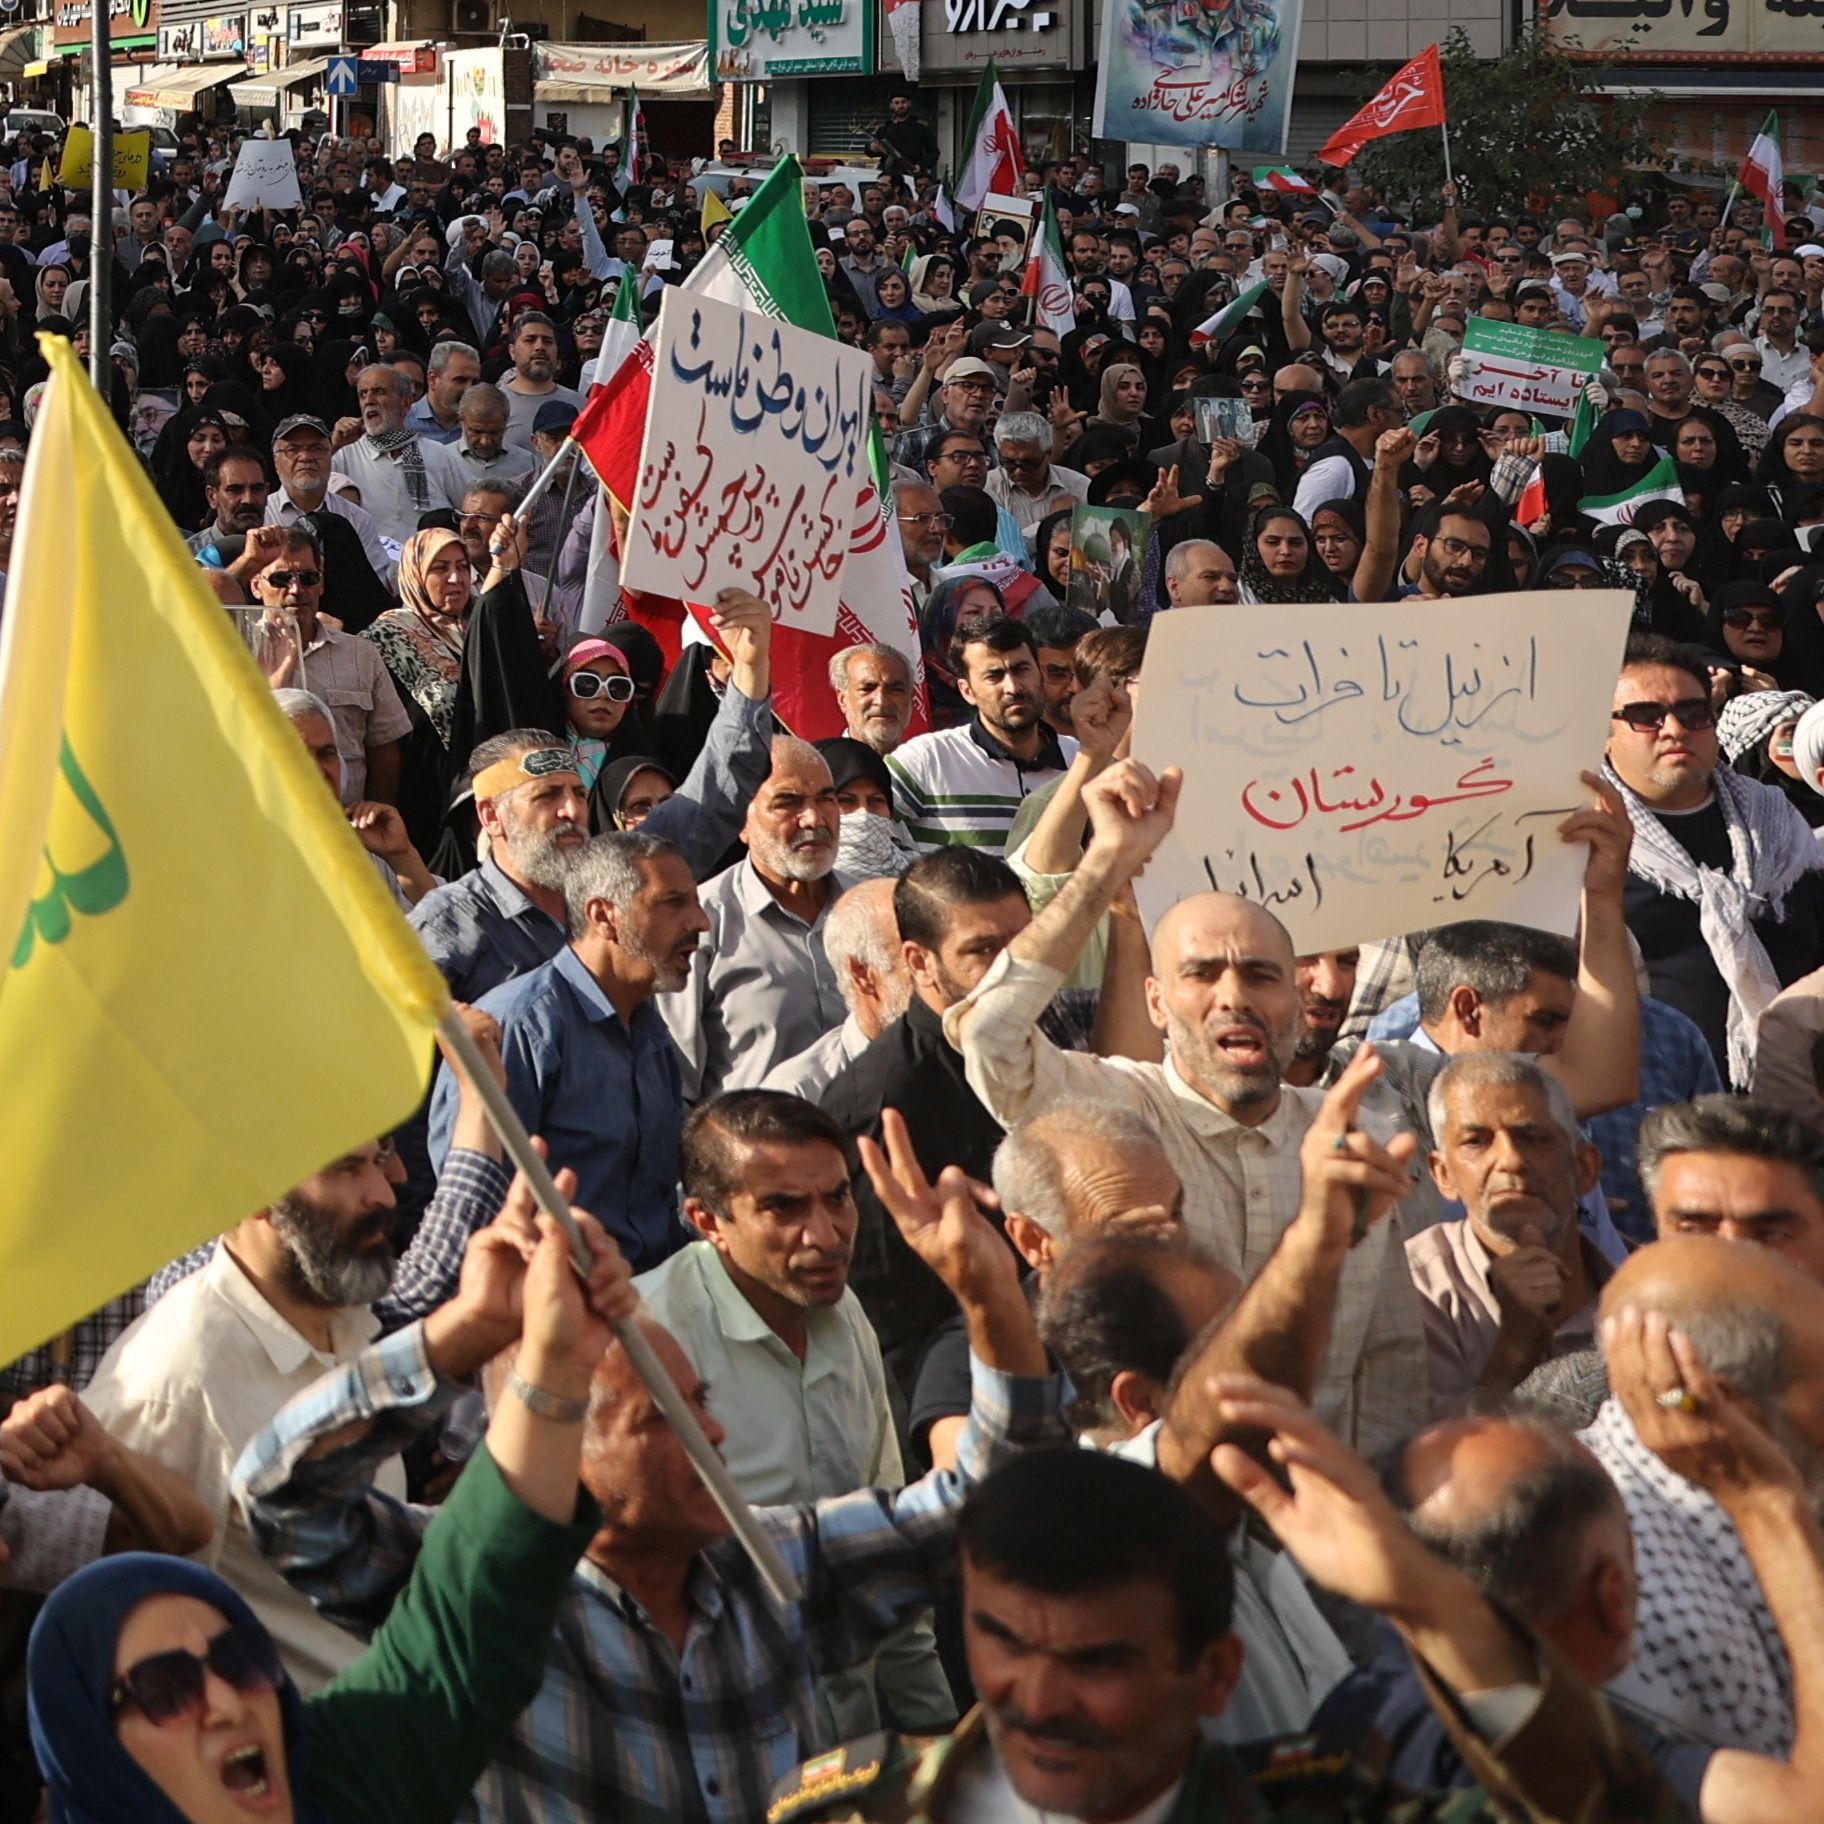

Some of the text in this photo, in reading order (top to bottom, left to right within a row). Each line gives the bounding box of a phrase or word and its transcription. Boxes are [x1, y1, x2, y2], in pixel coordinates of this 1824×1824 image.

[594, 53, 640, 75] خانه
[670, 308, 750, 399] ماست
[801, 357, 865, 478] ایران
[1233, 634, 1536, 746] از نیل تا فرات
[1241, 756, 1514, 833] گورستان
